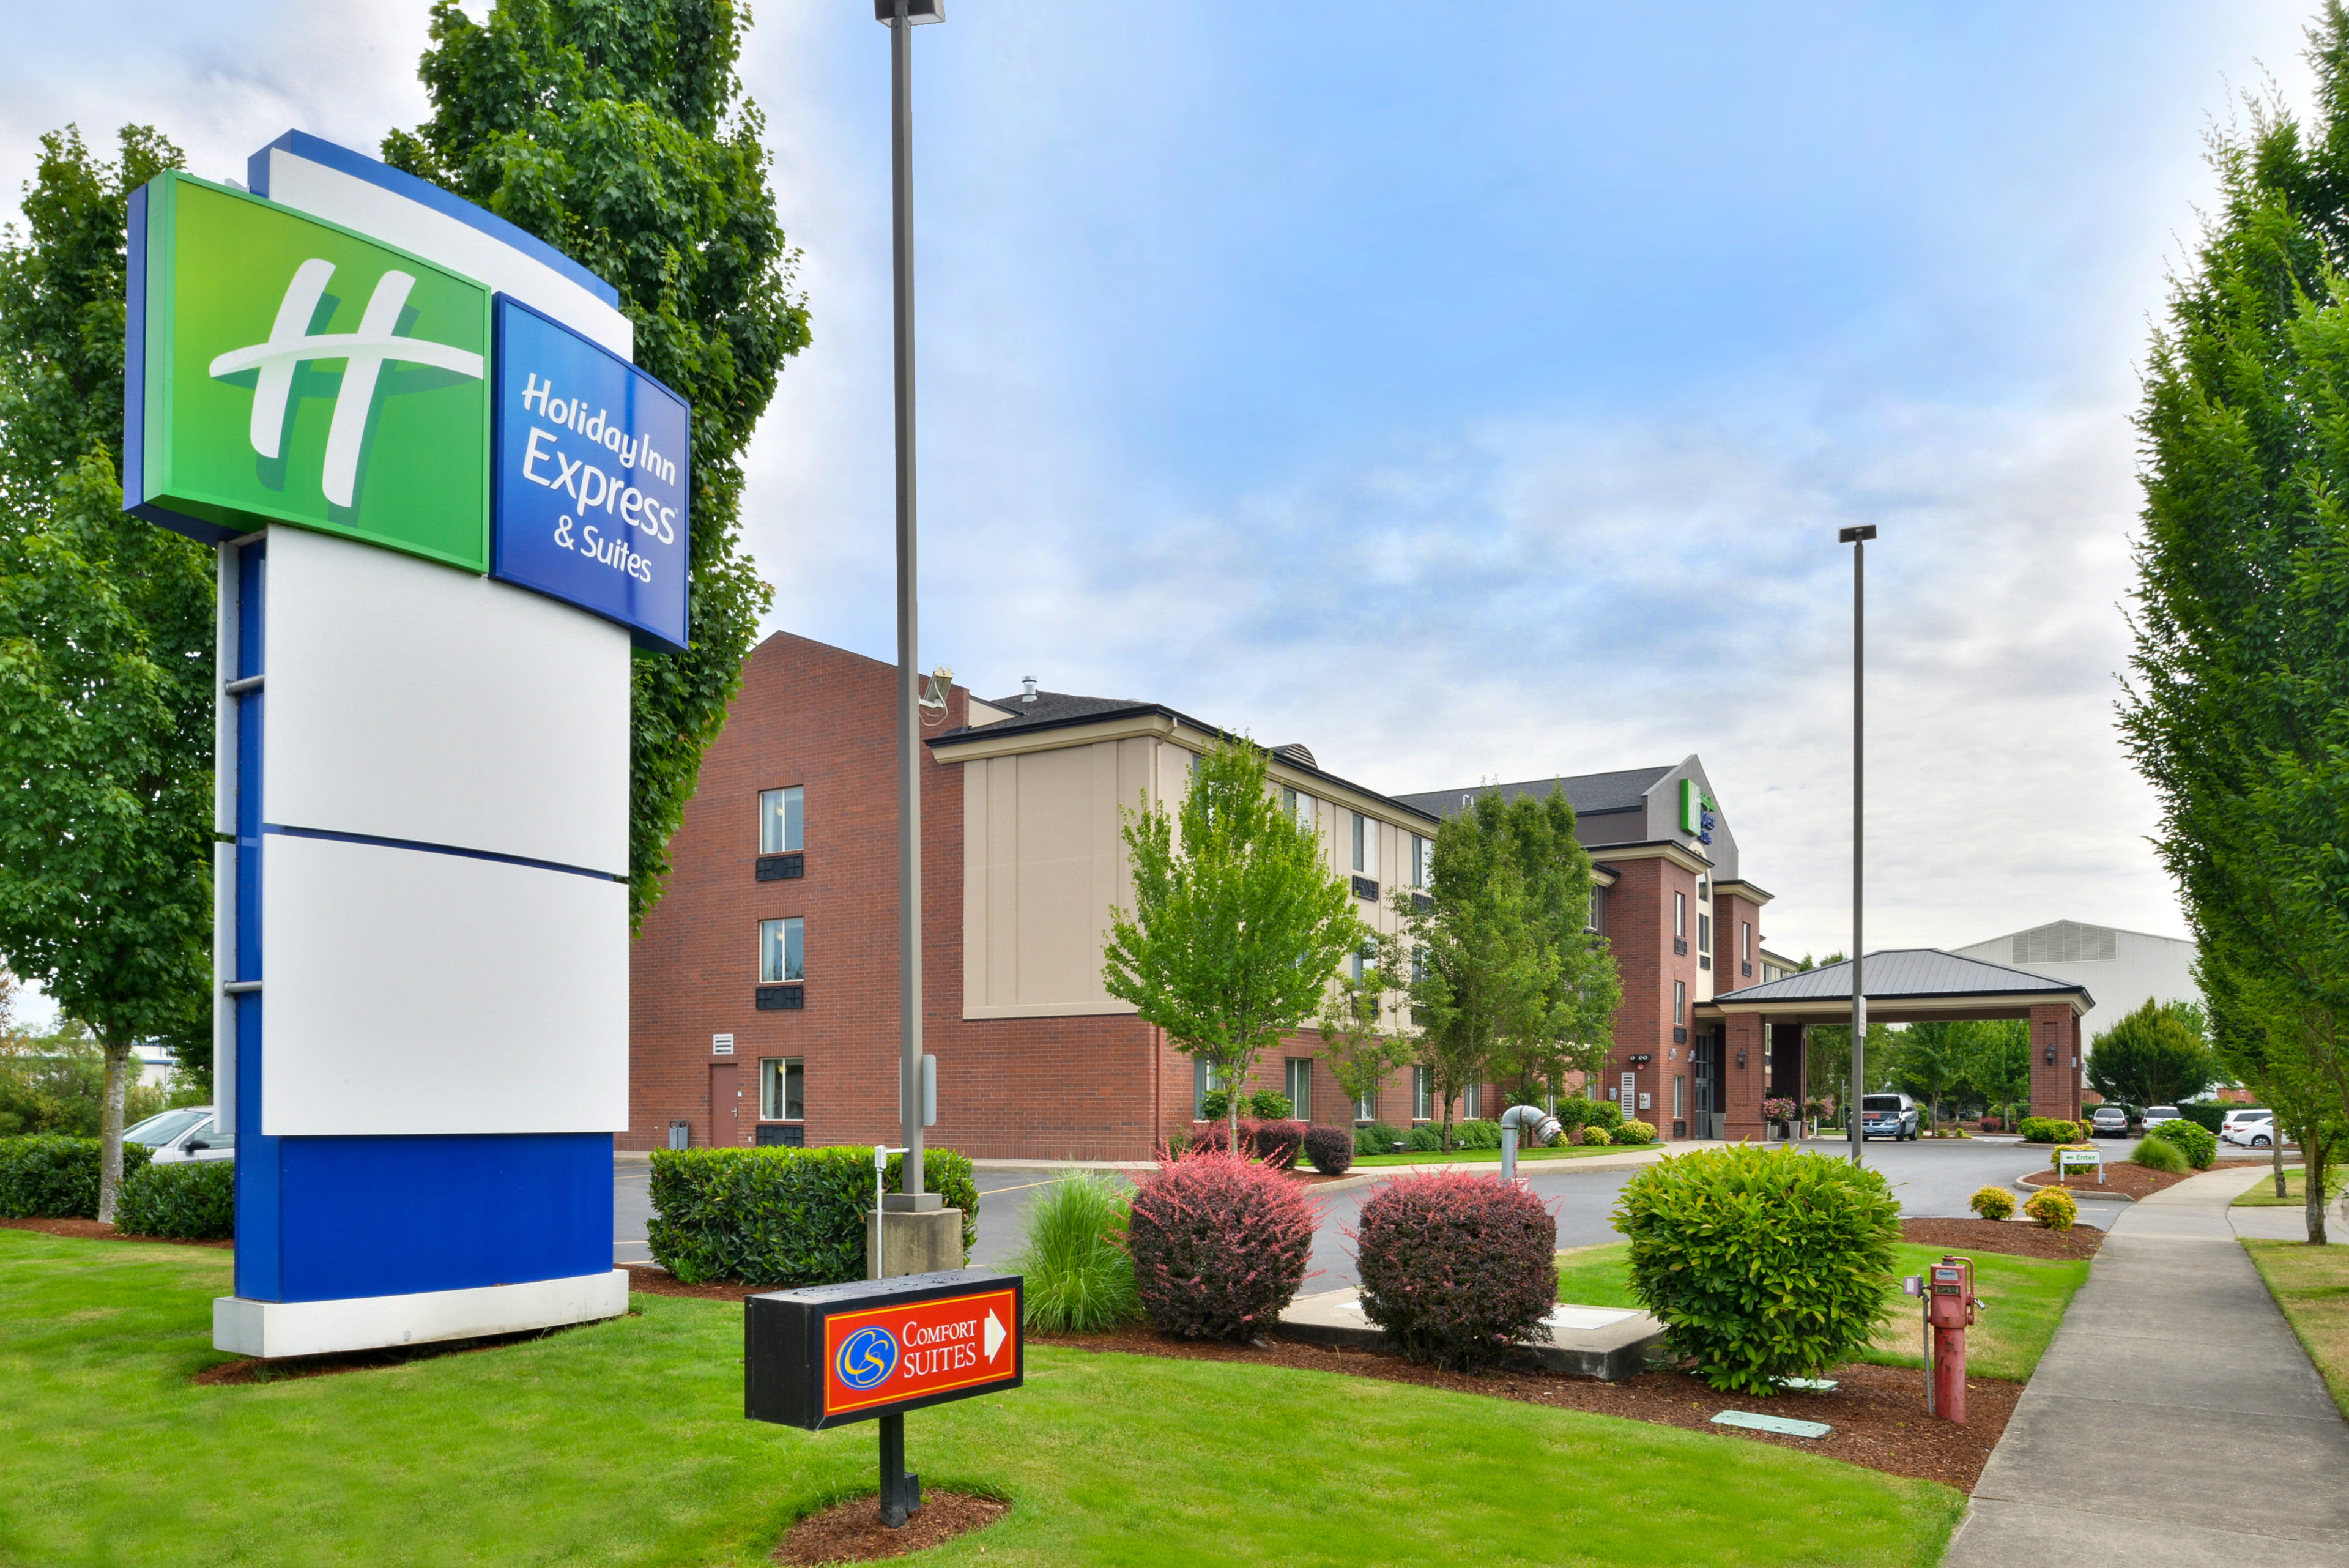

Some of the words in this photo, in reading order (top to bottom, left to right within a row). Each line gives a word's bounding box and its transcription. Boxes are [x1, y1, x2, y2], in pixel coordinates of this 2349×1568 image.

[522, 372, 638, 469] Holiday
[640, 433, 675, 486] Inn
[522, 426, 675, 545] Express
[554, 515, 574, 551] &
[581, 526, 651, 583] Suites
[902, 1320, 977, 1347] COMFORT
[904, 1342, 977, 1378] SUITES
